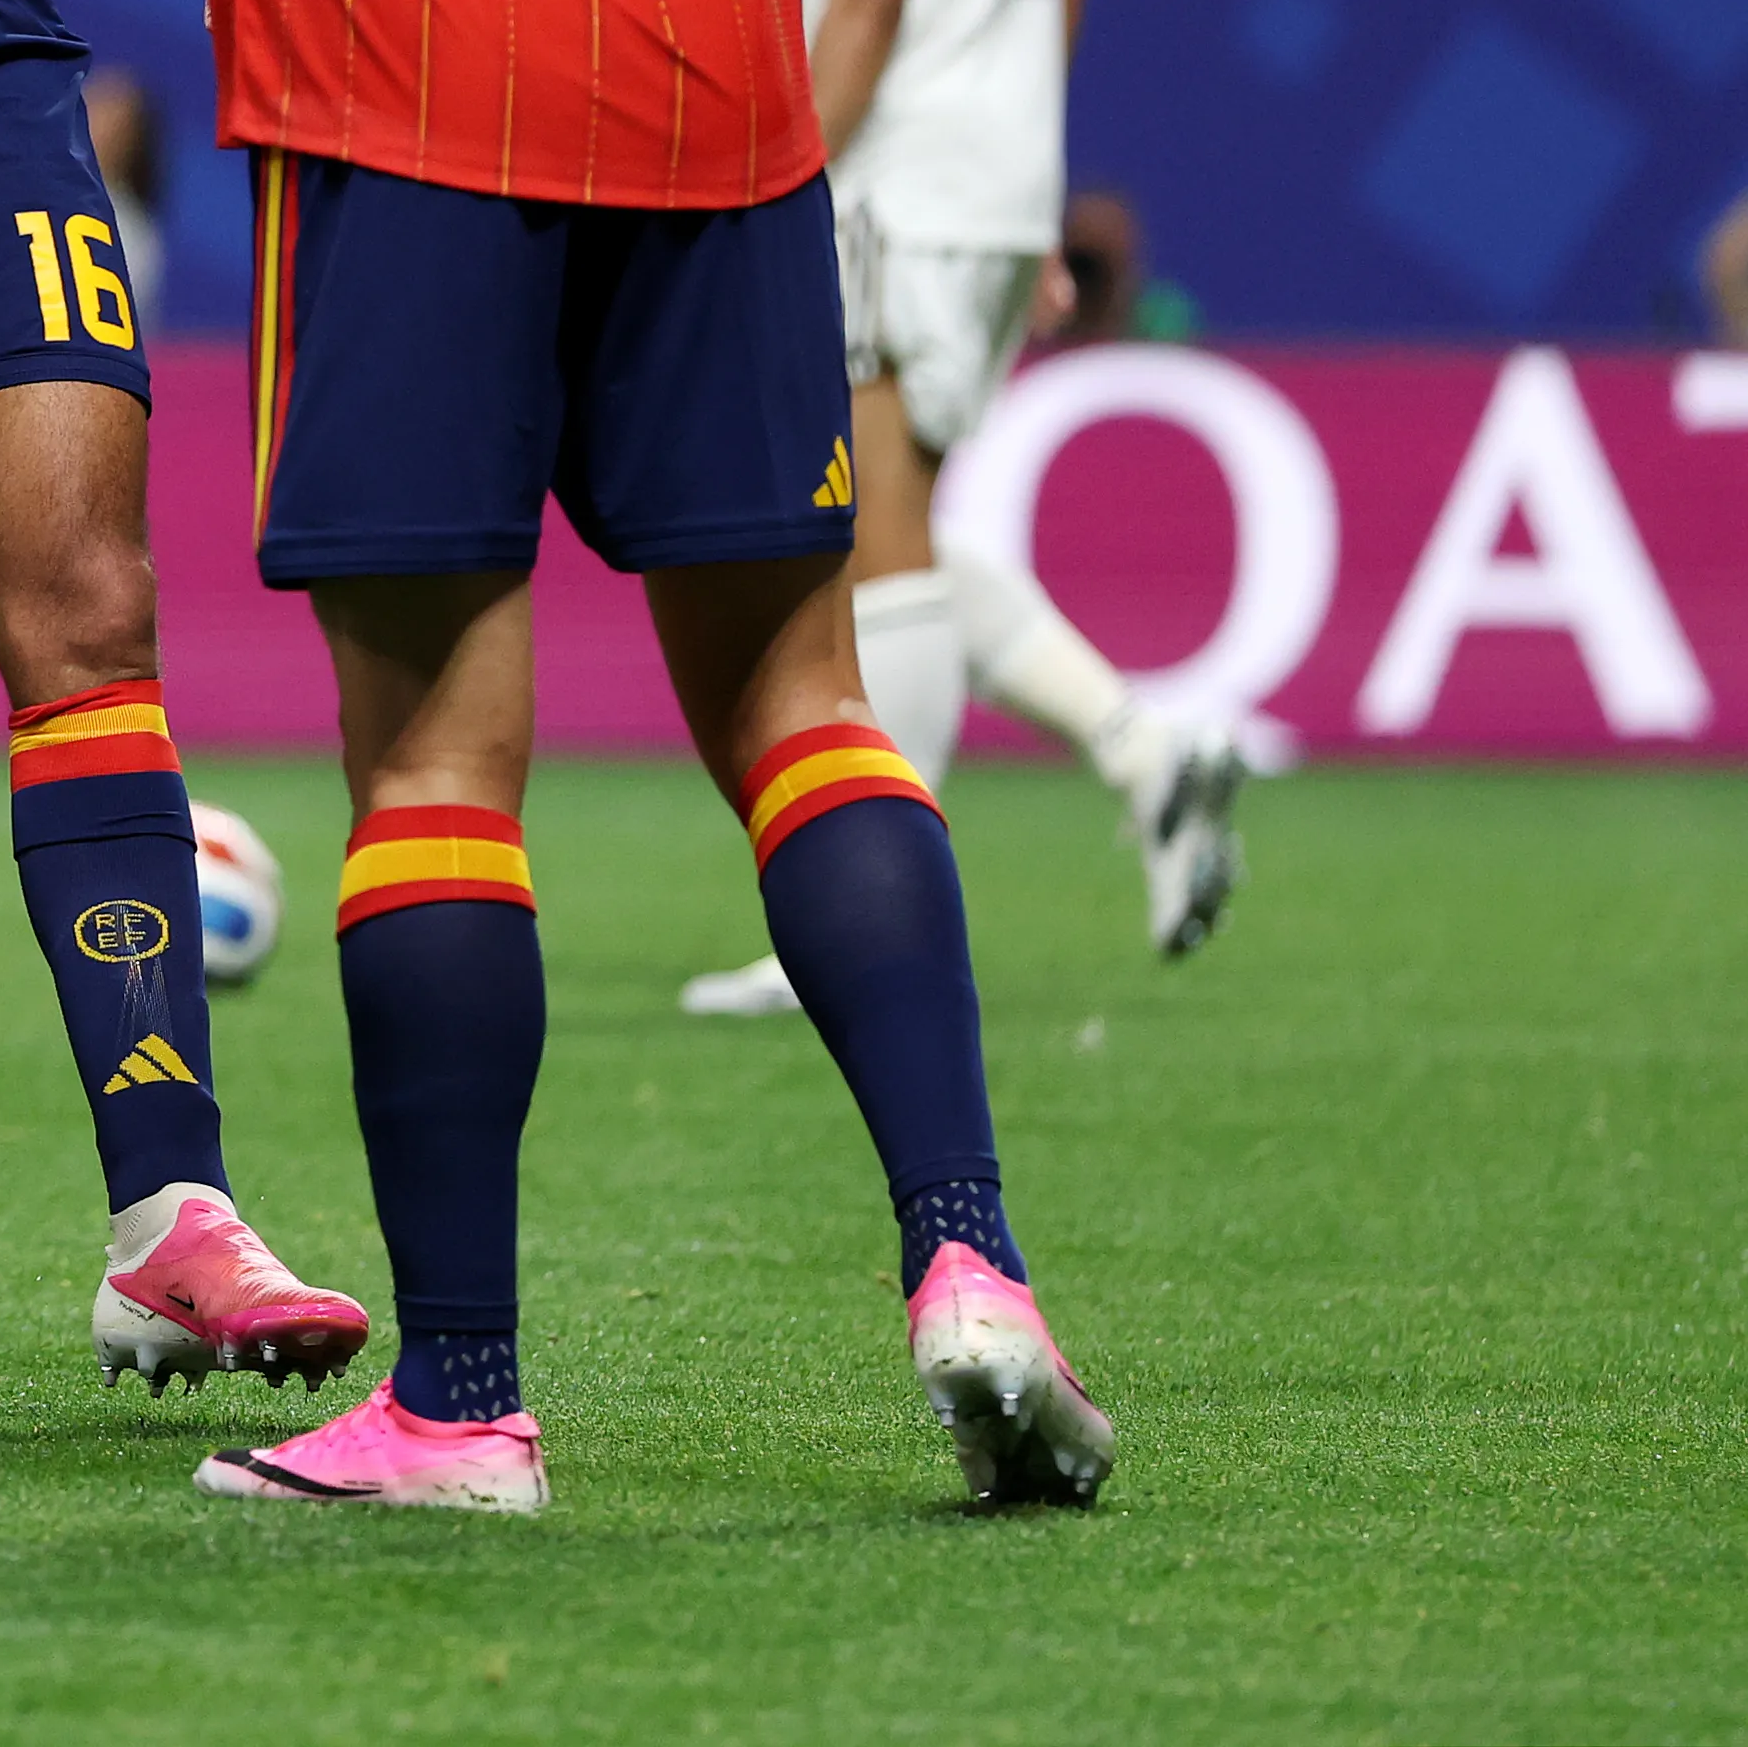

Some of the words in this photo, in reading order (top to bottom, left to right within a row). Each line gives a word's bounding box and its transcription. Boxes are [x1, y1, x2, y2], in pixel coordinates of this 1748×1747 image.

[15, 209, 135, 351] 16
[929, 340, 1748, 778] QA
[94, 912, 146, 931] RF
[97, 930, 147, 950] EF
